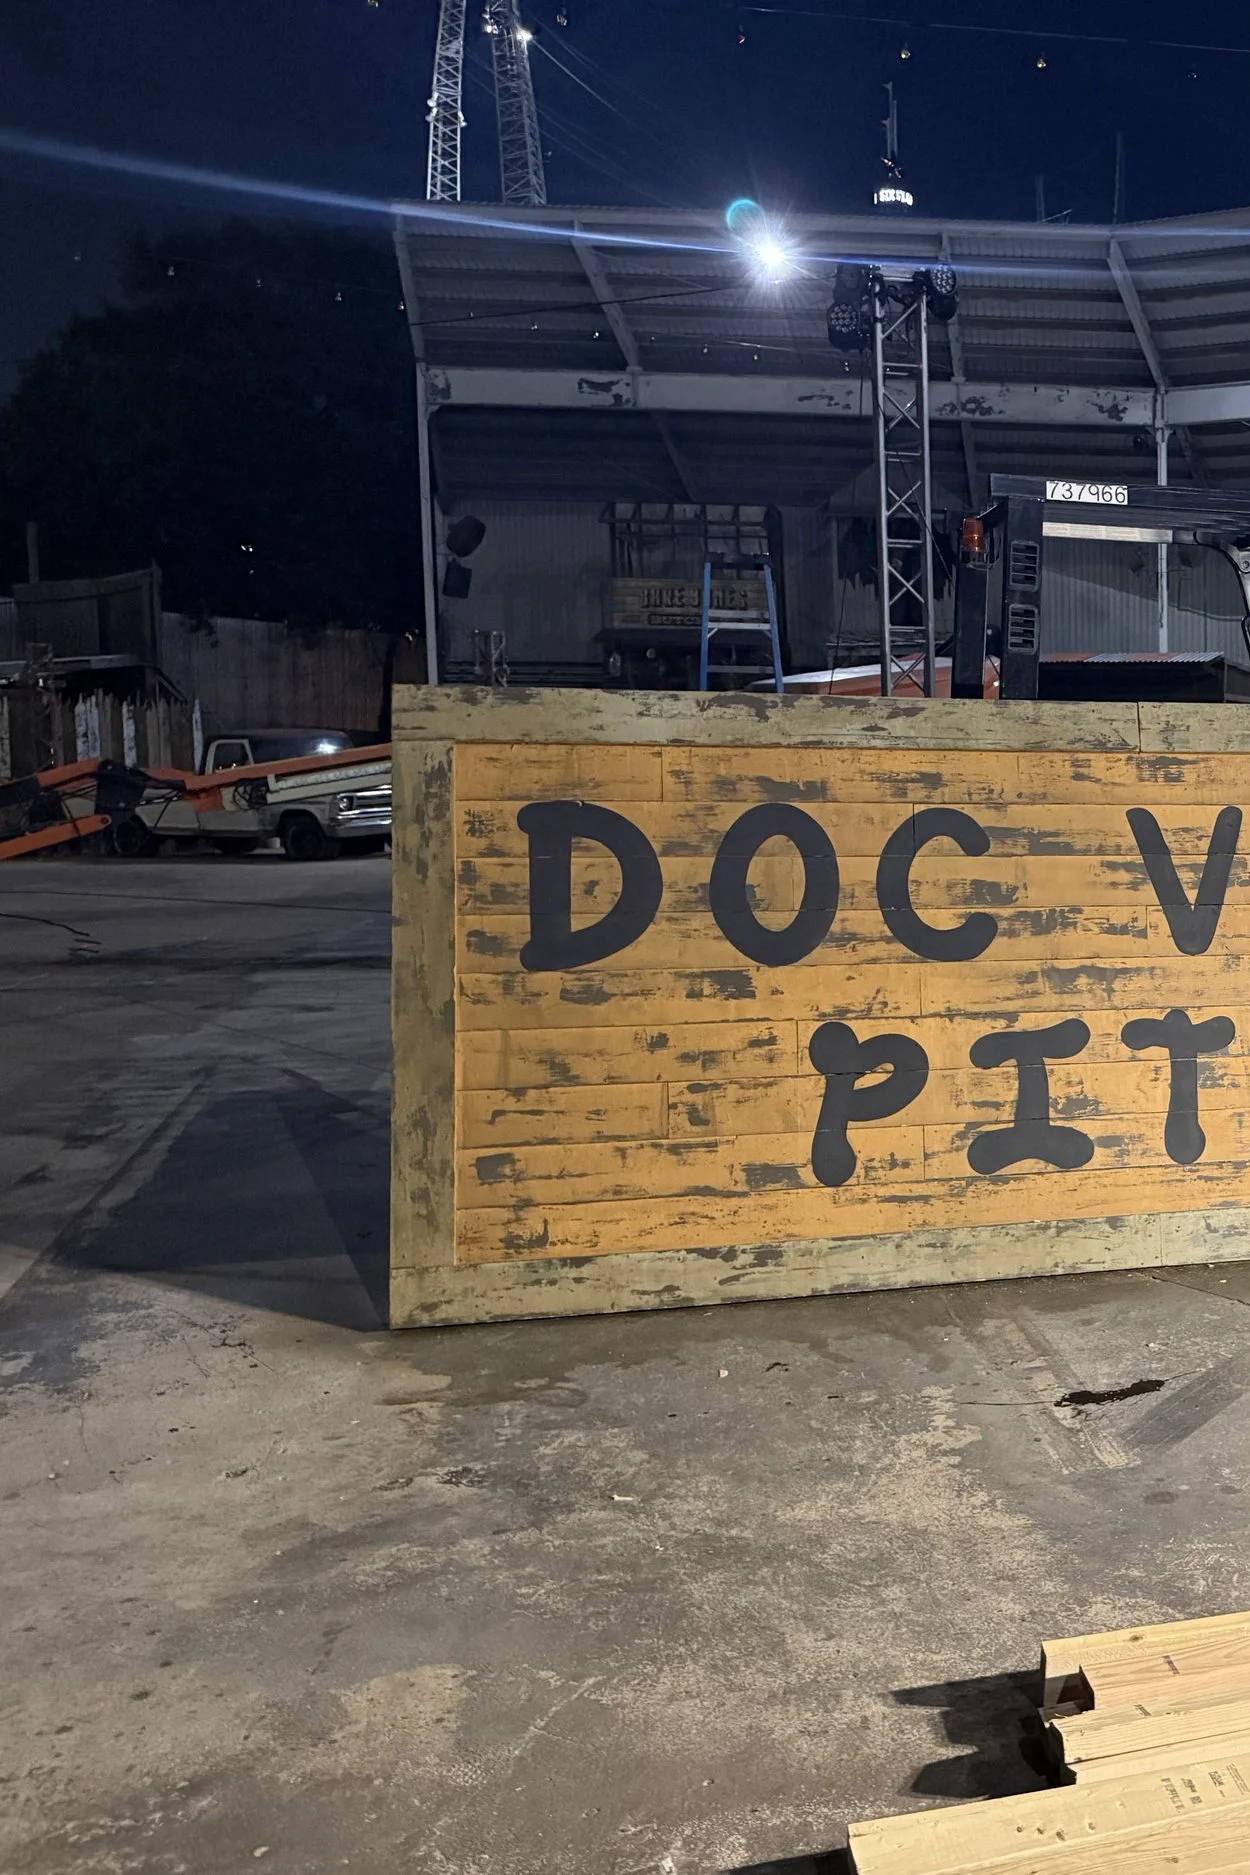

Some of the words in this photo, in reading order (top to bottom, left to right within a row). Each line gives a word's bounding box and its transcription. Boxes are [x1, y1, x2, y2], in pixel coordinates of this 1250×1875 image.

[1048, 481, 1127, 504] 737966
[516, 800, 998, 971] DOC
[808, 1009, 1236, 1186] PIT
